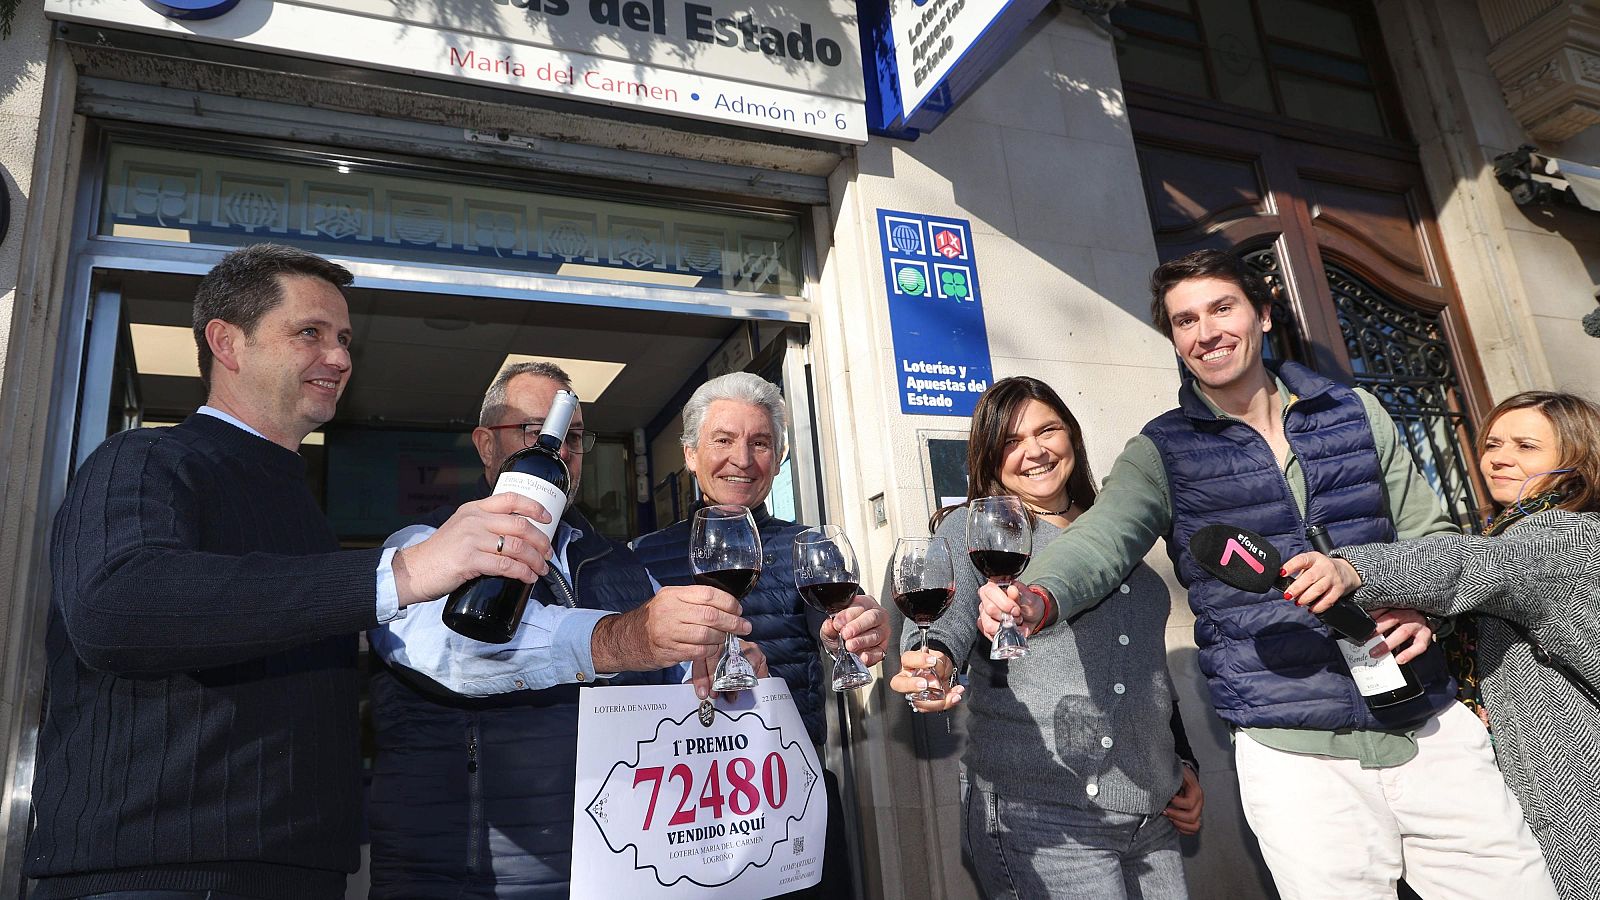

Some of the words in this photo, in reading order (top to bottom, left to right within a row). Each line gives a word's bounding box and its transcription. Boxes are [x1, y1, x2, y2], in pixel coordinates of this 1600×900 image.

[686, 1, 842, 67] Estado
[914, 35, 954, 88] Estado
[449, 46, 526, 78] María
[537, 62, 574, 86] del
[584, 70, 679, 103] Carmen
[714, 93, 795, 124] Admón
[835, 112, 847, 131] 6
[903, 359, 957, 375] Loterías
[958, 365, 967, 379] y
[906, 375, 967, 393] Apuestas
[967, 379, 987, 393] del
[907, 392, 953, 408] Estado
[527, 478, 557, 499] Valpiedra
[1237, 533, 1259, 554] Rioja
[1258, 549, 1267, 559] La
[627, 704, 637, 712] DE
[638, 703, 668, 711] NAVIDAD
[685, 733, 749, 755] PREMIO
[632, 751, 788, 831] 72480
[667, 823, 726, 845] VENDIDO
[729, 813, 766, 836] AQUÍ
[721, 841, 735, 851] DEL
[735, 836, 764, 848] CARMEN
[702, 852, 734, 865] LOGROÑO
